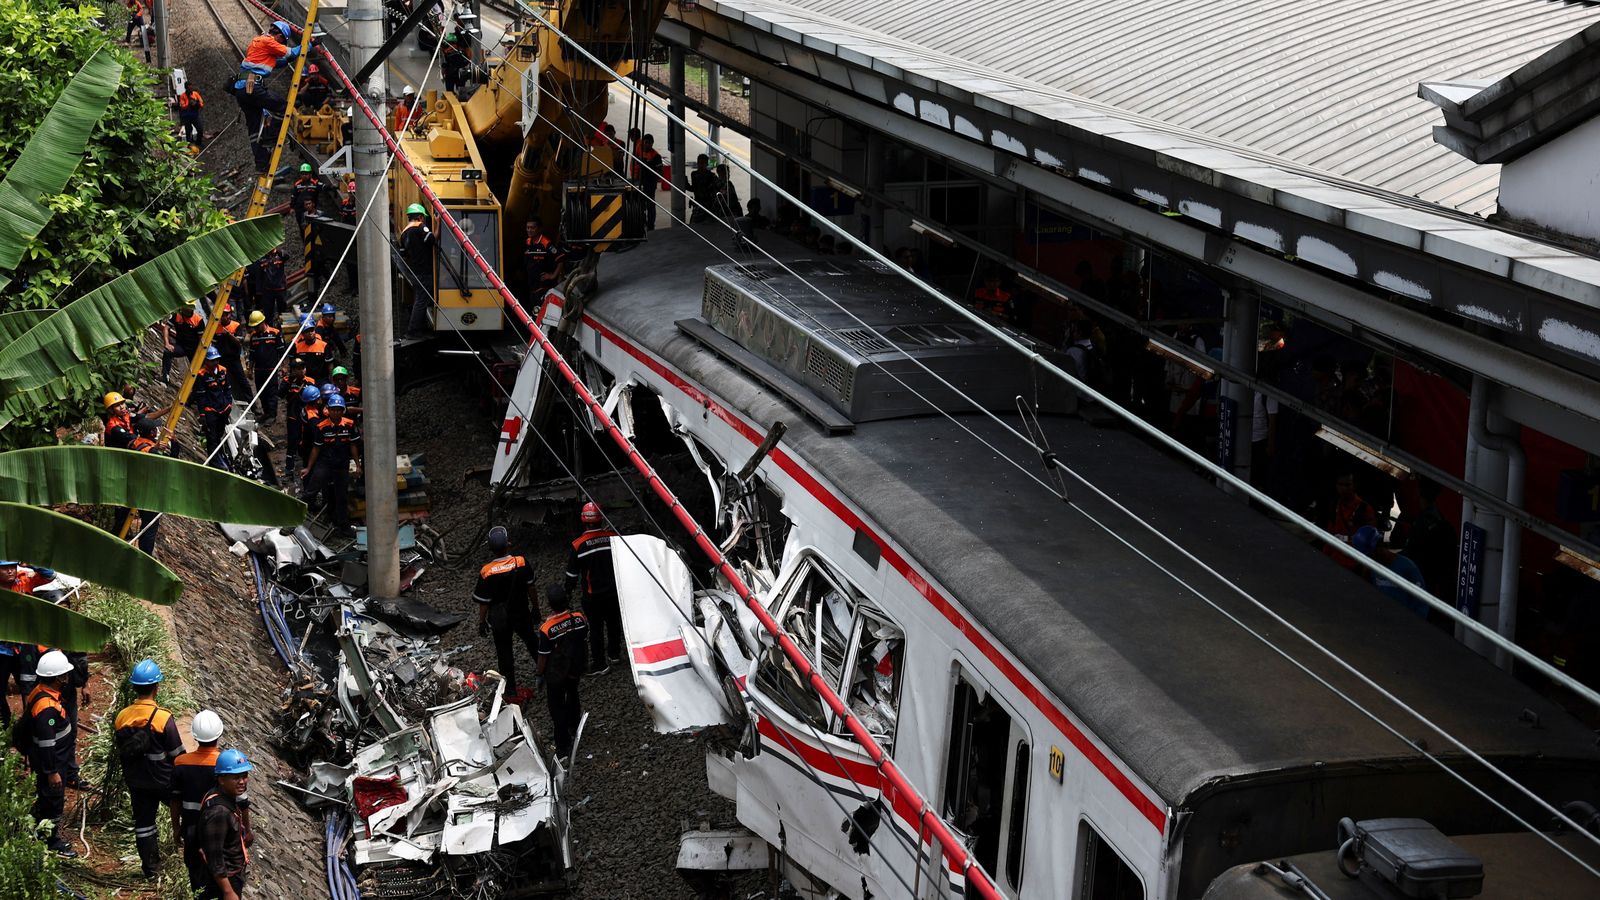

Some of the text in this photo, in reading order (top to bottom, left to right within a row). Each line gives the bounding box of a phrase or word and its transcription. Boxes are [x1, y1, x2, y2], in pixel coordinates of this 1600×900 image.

[1587, 484, 1600, 512] 1
[1460, 530, 1470, 597] BEKASI
[1468, 540, 1477, 596] TIMUR
